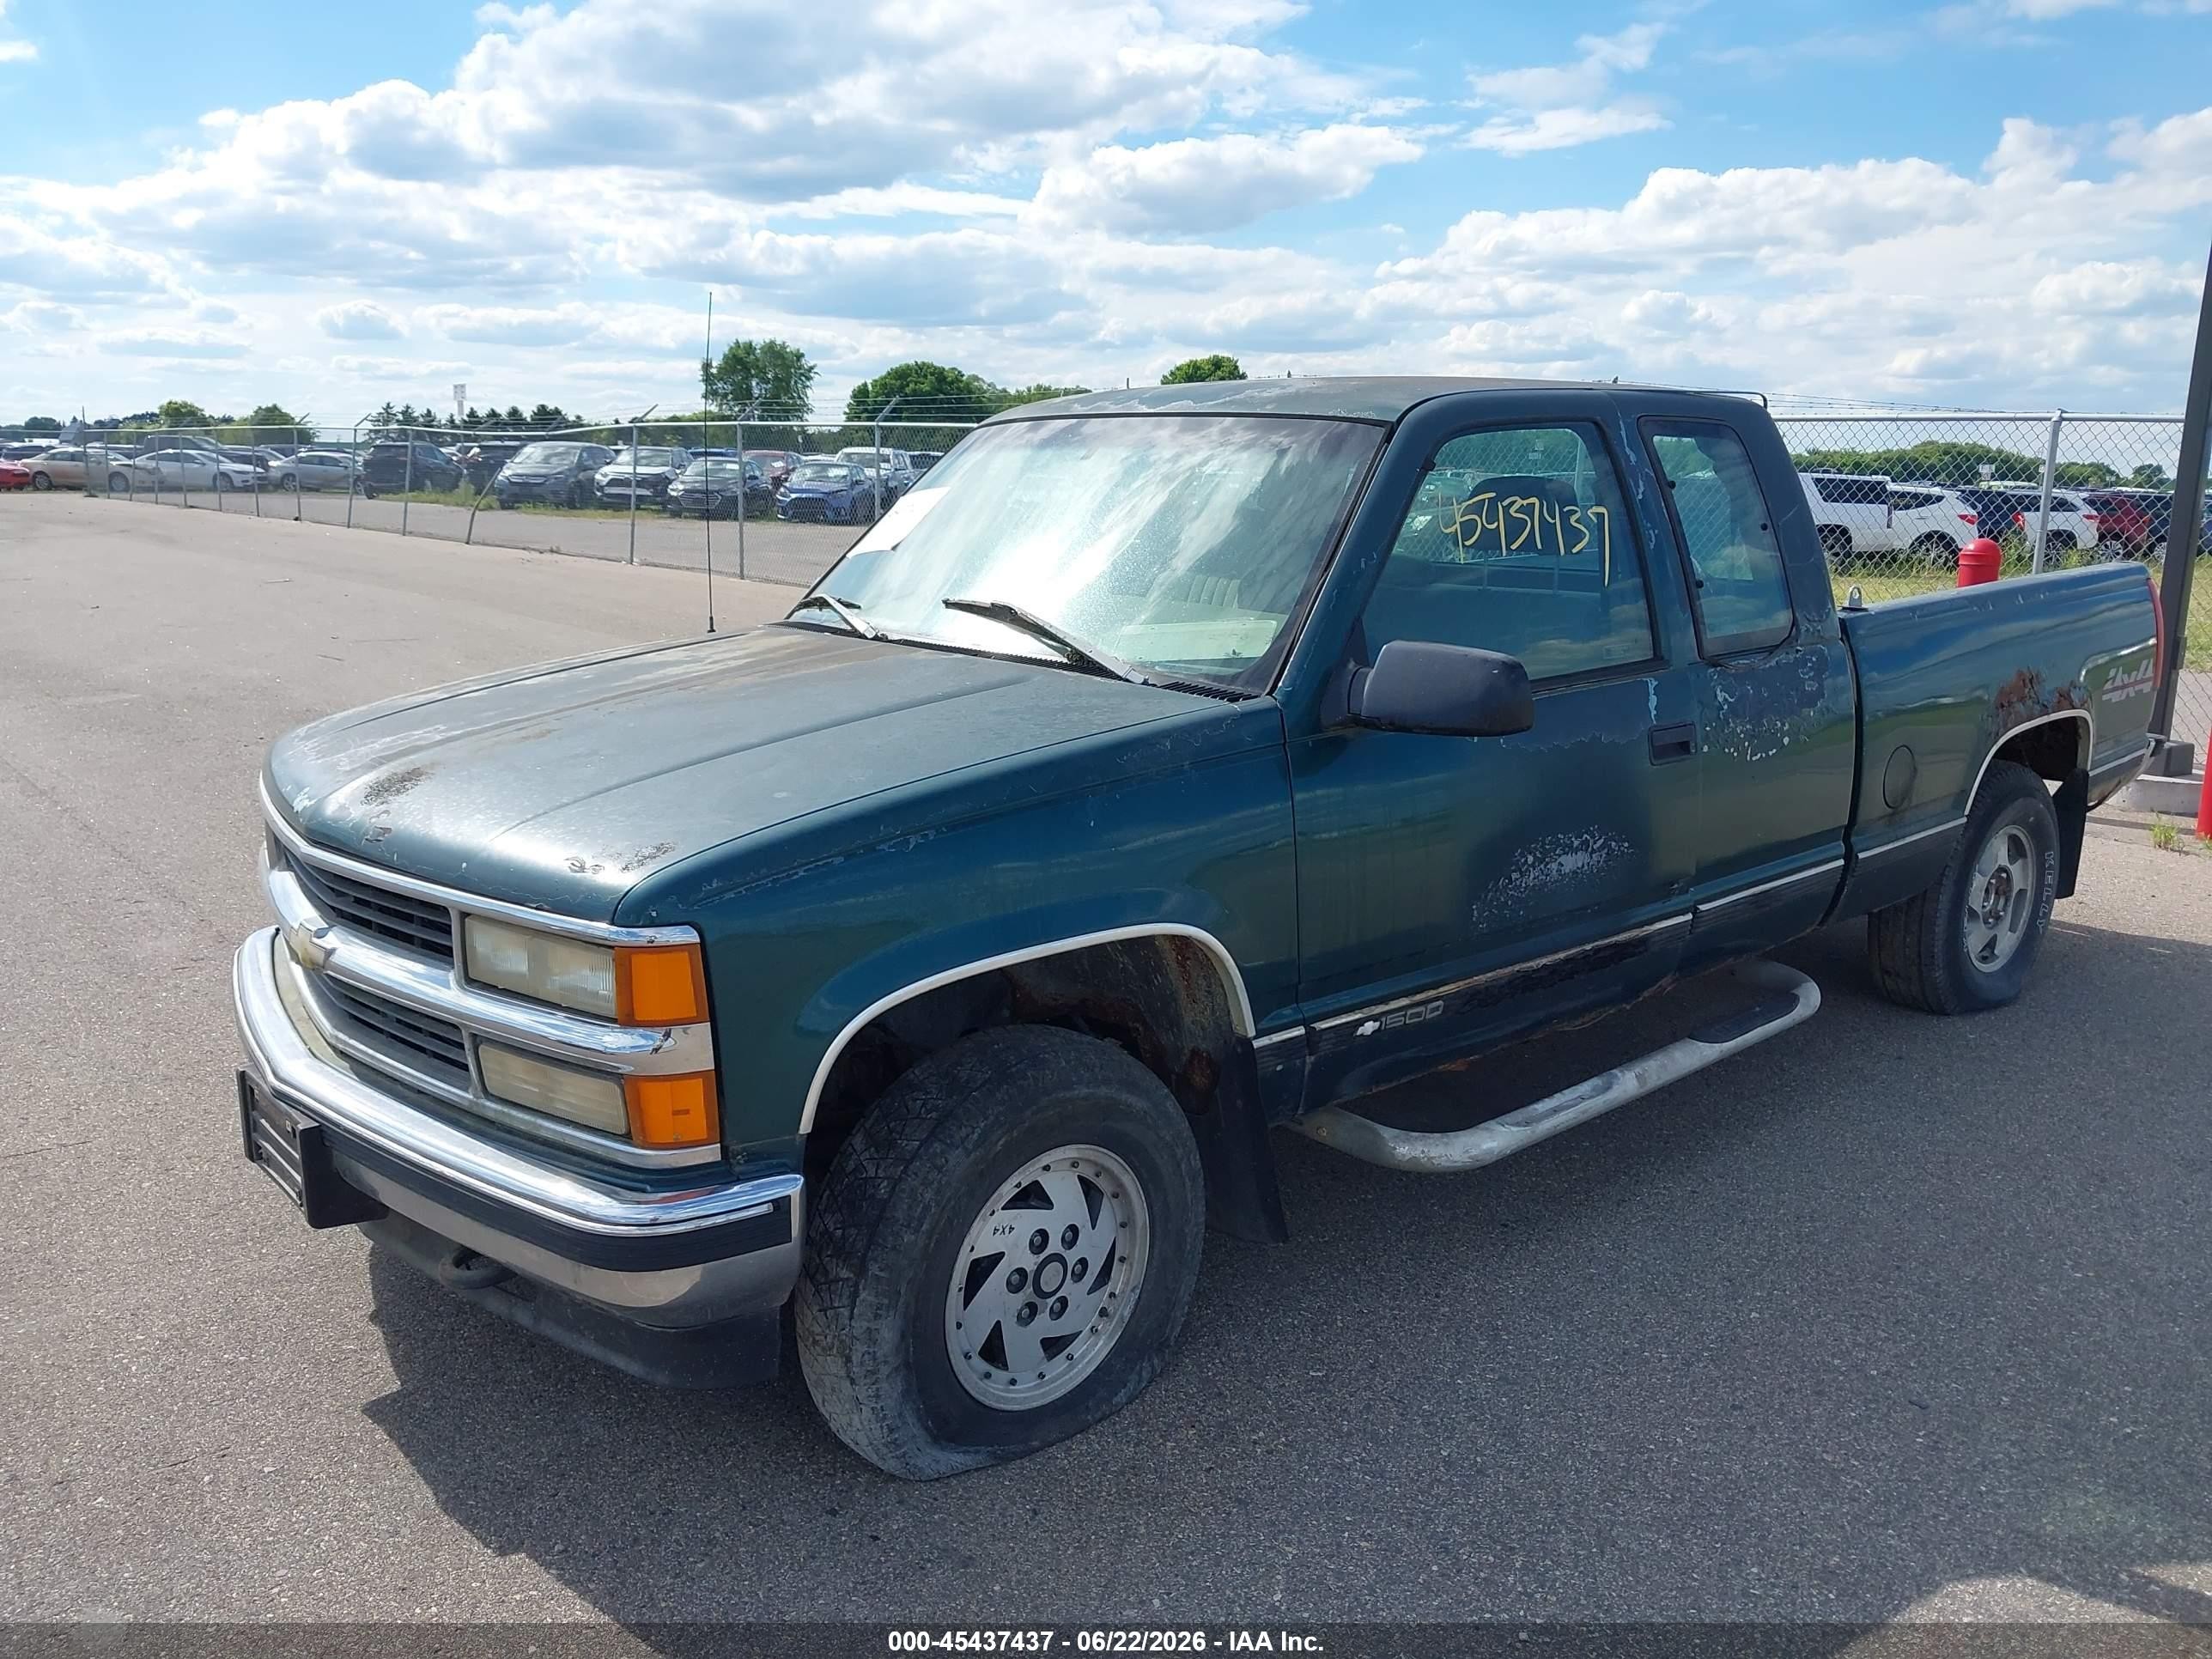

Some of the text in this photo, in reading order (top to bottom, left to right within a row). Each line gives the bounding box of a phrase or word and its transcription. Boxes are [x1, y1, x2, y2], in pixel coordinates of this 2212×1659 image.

[1439, 492, 1610, 587] 45437437
[2037, 851, 2055, 934] KELLY
[1381, 1000, 1443, 1030] 1500
